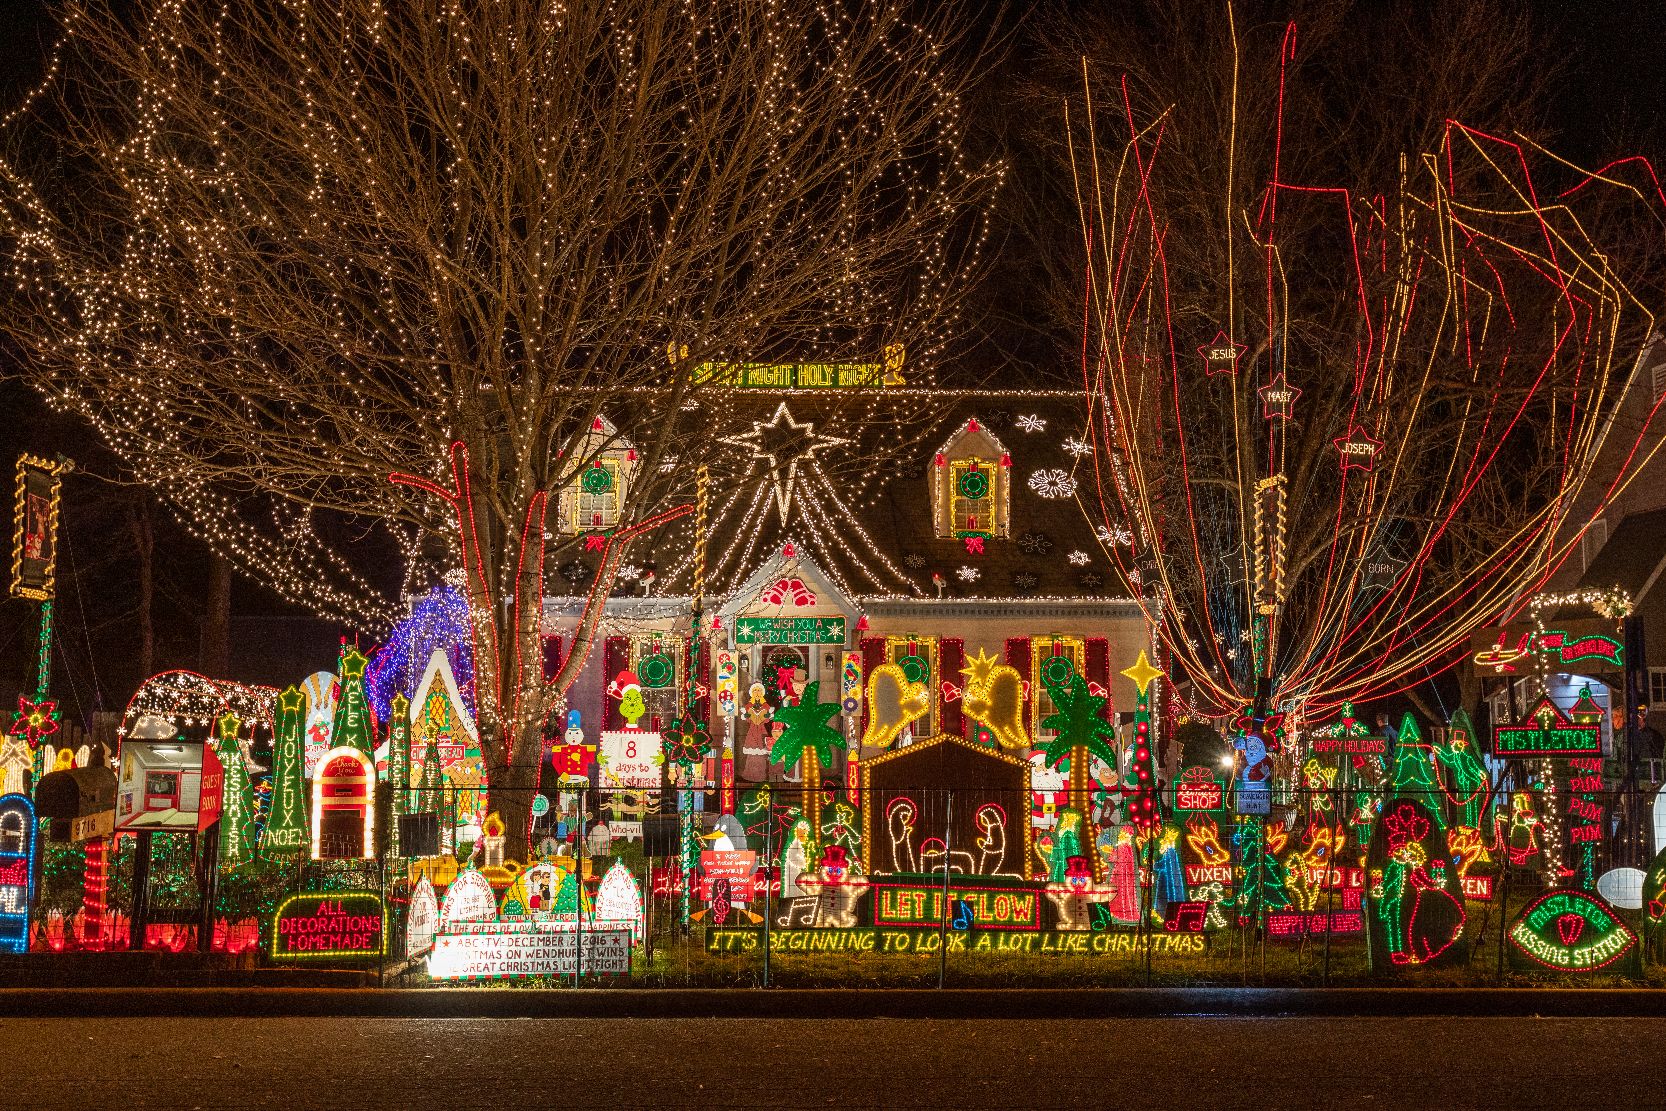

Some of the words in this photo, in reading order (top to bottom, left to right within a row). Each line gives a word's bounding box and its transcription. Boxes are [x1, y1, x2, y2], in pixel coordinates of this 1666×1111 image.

[1208, 348, 1236, 360] JESUS
[748, 363, 793, 386] NIGHT
[798, 363, 833, 386] HOLY
[838, 363, 882, 386] NIGHT
[1267, 391, 1293, 402] MARY
[1341, 443, 1375, 455] JOSEPH
[1368, 562, 1394, 574] BORN
[758, 619, 771, 629] WE
[772, 619, 794, 629] WISH
[797, 619, 815, 629] YOU
[816, 620, 822, 629] A
[754, 631, 780, 643] MERRY
[781, 631, 827, 643] CHRISTMAS
[1314, 739, 1343, 753] HAPPY
[1344, 739, 1386, 753] HOLIDAYS
[1498, 730, 1596, 750] MISTLETOE
[625, 740, 637, 758] 8
[615, 762, 637, 774] days
[638, 763, 650, 773] to
[202, 773, 221, 790] GUEST
[282, 731, 296, 827] JOYEUX
[1570, 775, 1604, 792] PUM
[1181, 795, 1218, 809] SHOP
[1567, 796, 1605, 822] PUM
[75, 819, 96, 836] 9716
[1570, 824, 1603, 844] PUM
[267, 828, 308, 847] NOEL
[1188, 867, 1232, 882] VIXEN
[453, 876, 468, 895] FOR
[317, 900, 346, 916] ALL
[882, 890, 926, 919] LET
[280, 915, 380, 934] DECORATIONS
[472, 924, 497, 933] GIFTS
[587, 922, 632, 931] HAPPINESS
[288, 932, 372, 951] HOMEMADE
[582, 935, 607, 946] 2016
[710, 931, 758, 950] IT'S
[768, 932, 876, 950] BEGINNING
[882, 932, 910, 951] TO
[916, 932, 968, 951] LOOK
[977, 932, 991, 950] A
[998, 932, 1039, 950] LOT
[1042, 933, 1090, 951] LIKE
[1093, 933, 1205, 952] CHRISTMAS
[1512, 922, 1569, 965] KISSING
[1573, 927, 1633, 965] STATION
[506, 949, 522, 960] ON
[525, 947, 593, 959] WENDHURST
[597, 947, 625, 958] WINS
[499, 961, 559, 972] CHRISTMAS
[595, 959, 625, 970] FIGHT
